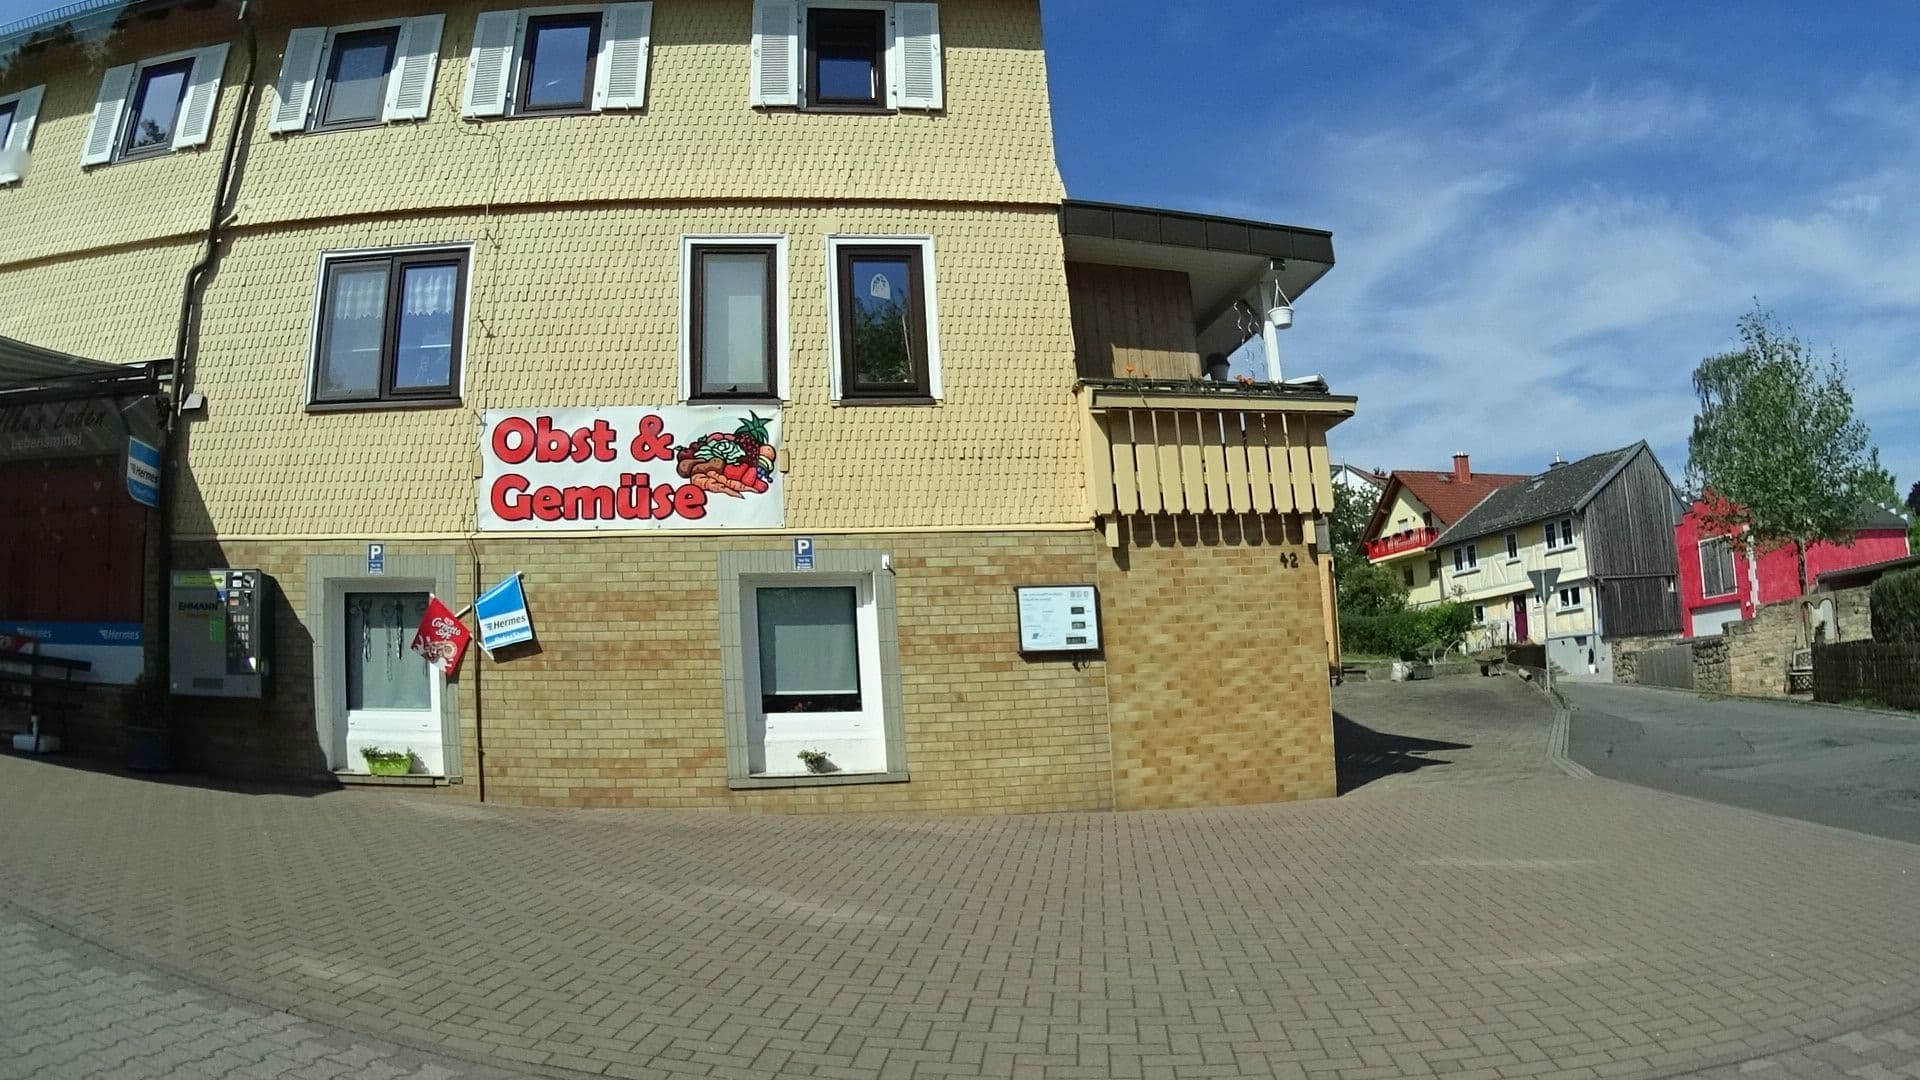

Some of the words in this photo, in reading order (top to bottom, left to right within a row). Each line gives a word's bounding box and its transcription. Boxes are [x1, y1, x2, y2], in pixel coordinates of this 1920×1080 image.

[491, 416, 617, 464] Obst
[630, 414, 674, 461] &
[135, 464, 159, 483] Hermes
[491, 473, 708, 521] Gemüse
[371, 545, 381, 559] P
[797, 539, 809, 554] P
[1280, 552, 1299, 569] 42
[178, 601, 218, 611] EHMANN
[493, 615, 526, 630] Hermes
[106, 629, 140, 640] Hermes
